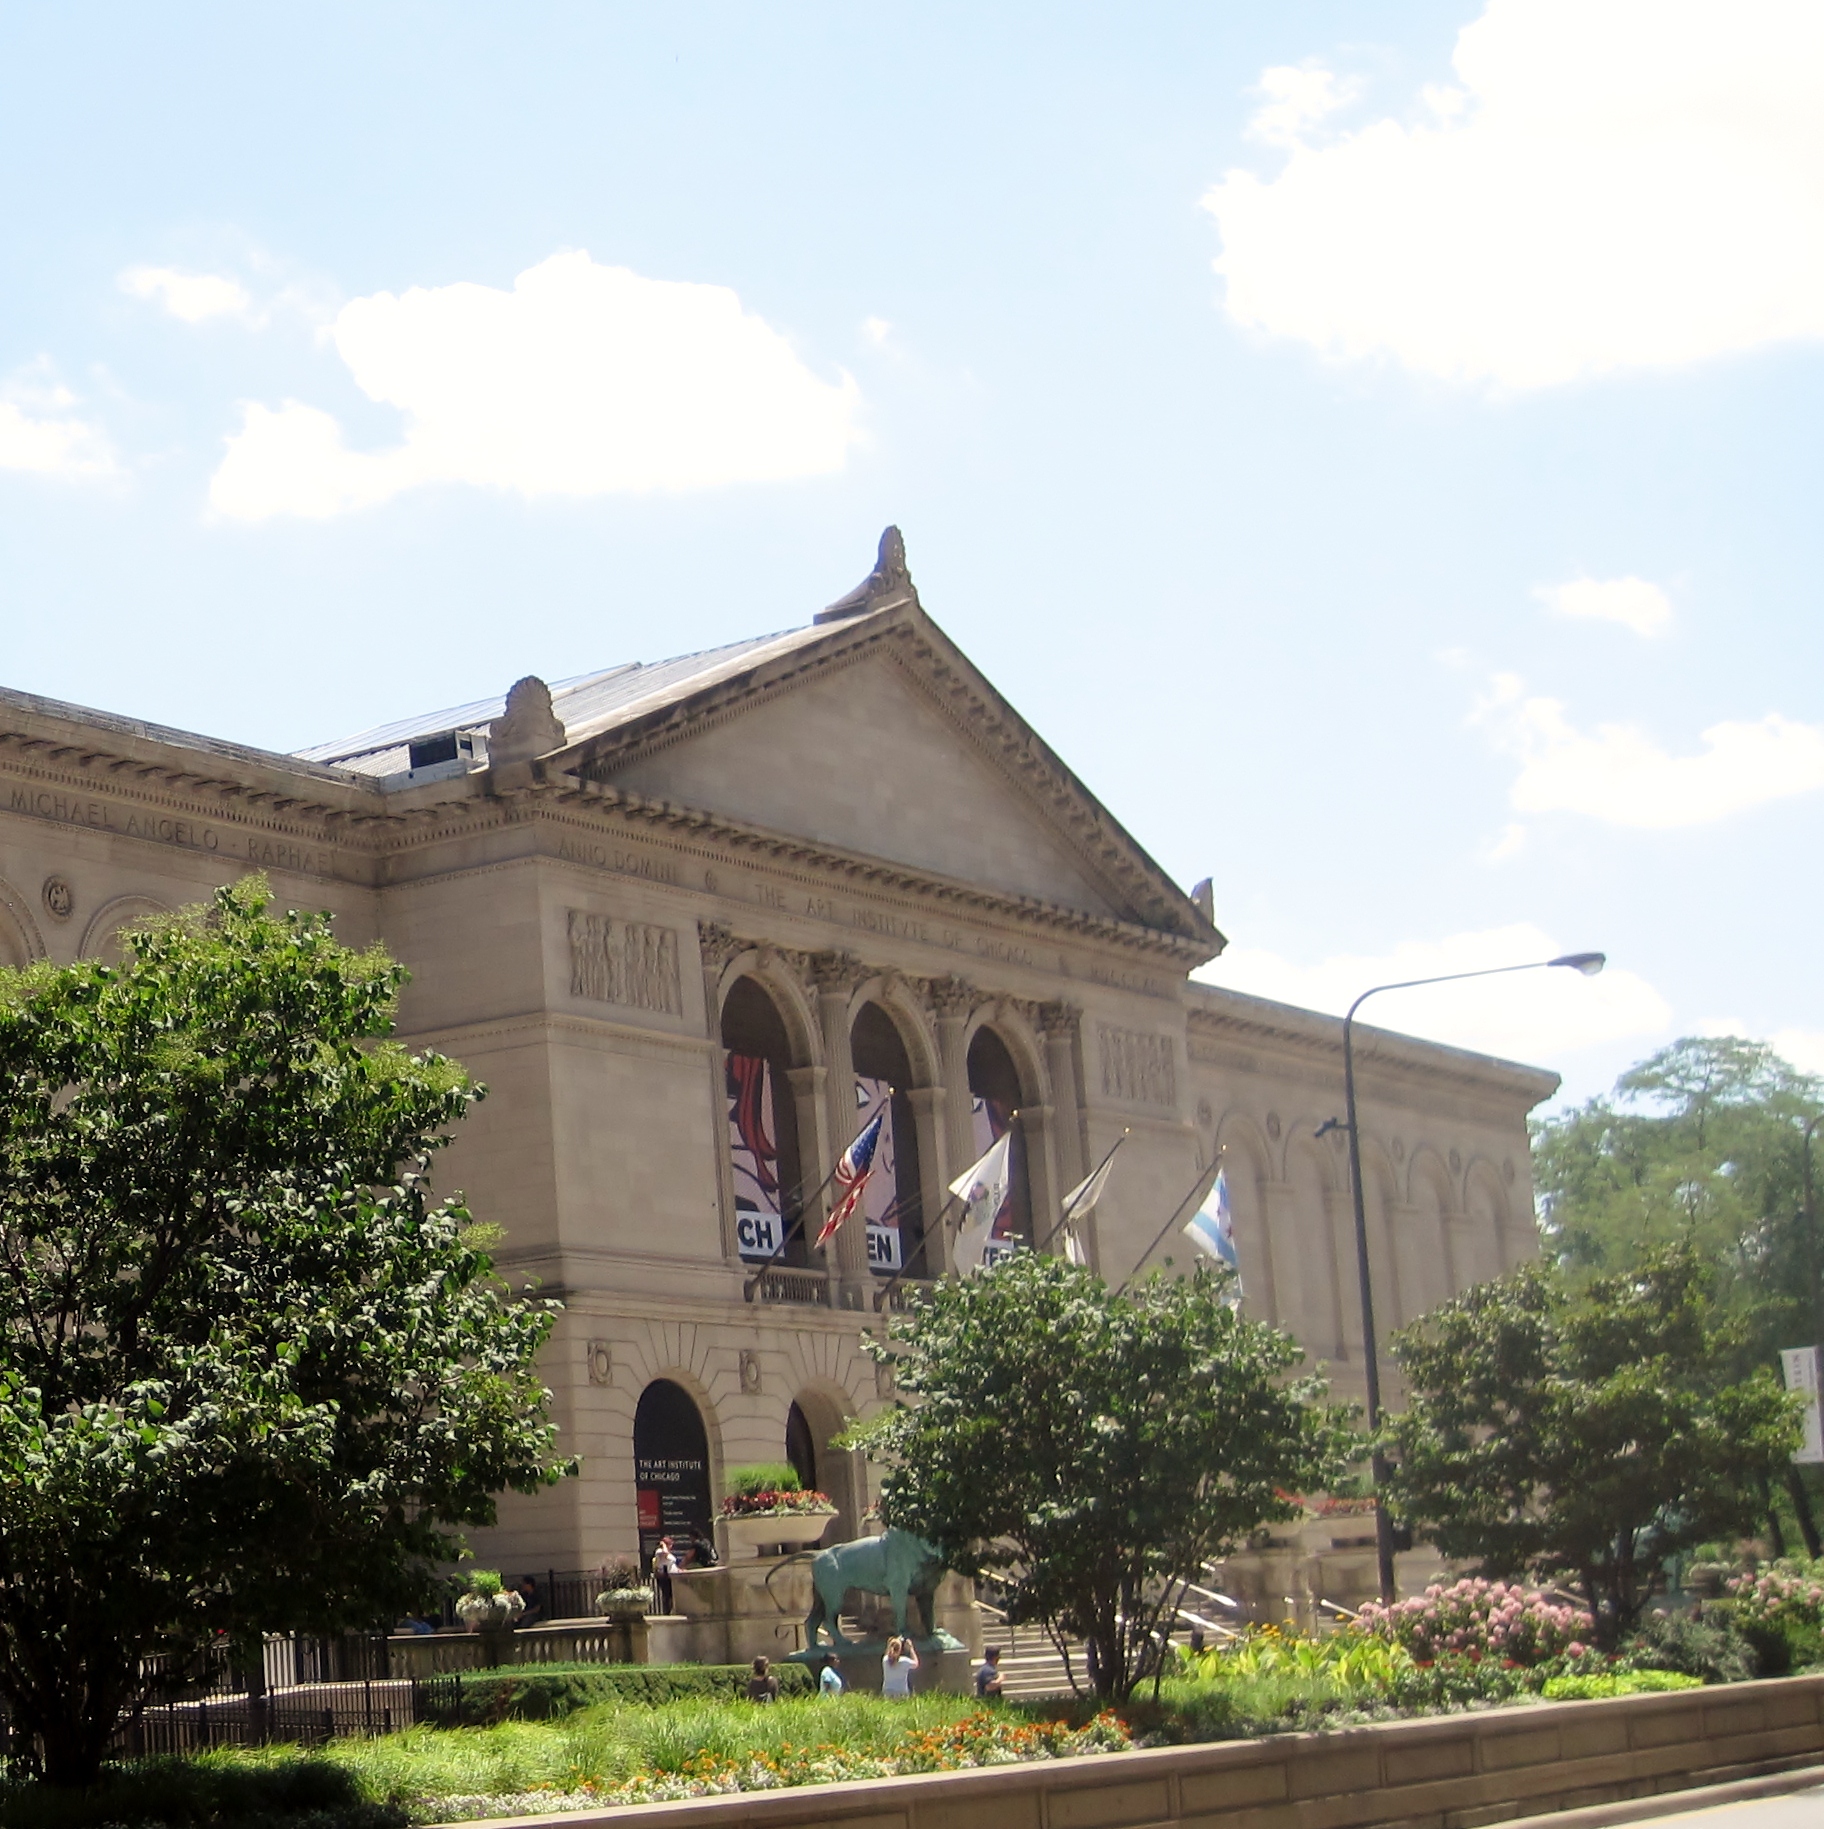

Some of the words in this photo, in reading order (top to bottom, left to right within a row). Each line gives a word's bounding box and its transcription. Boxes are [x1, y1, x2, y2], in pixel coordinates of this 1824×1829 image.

[10, 788, 110, 829] MICHAEL
[127, 812, 220, 852] ANGELO
[248, 836, 339, 877] RAPHAEL
[558, 836, 608, 867] ANNO
[614, 847, 678, 884] DOMINI
[754, 882, 786, 911] THE
[805, 896, 835, 921] ART
[639, 1459, 652, 1469] THE
[654, 1459, 666, 1469] ART
[668, 1460, 702, 1470] INSTITUTE
[639, 1471, 648, 1481] OF
[650, 1471, 680, 1482] CHICAGO
